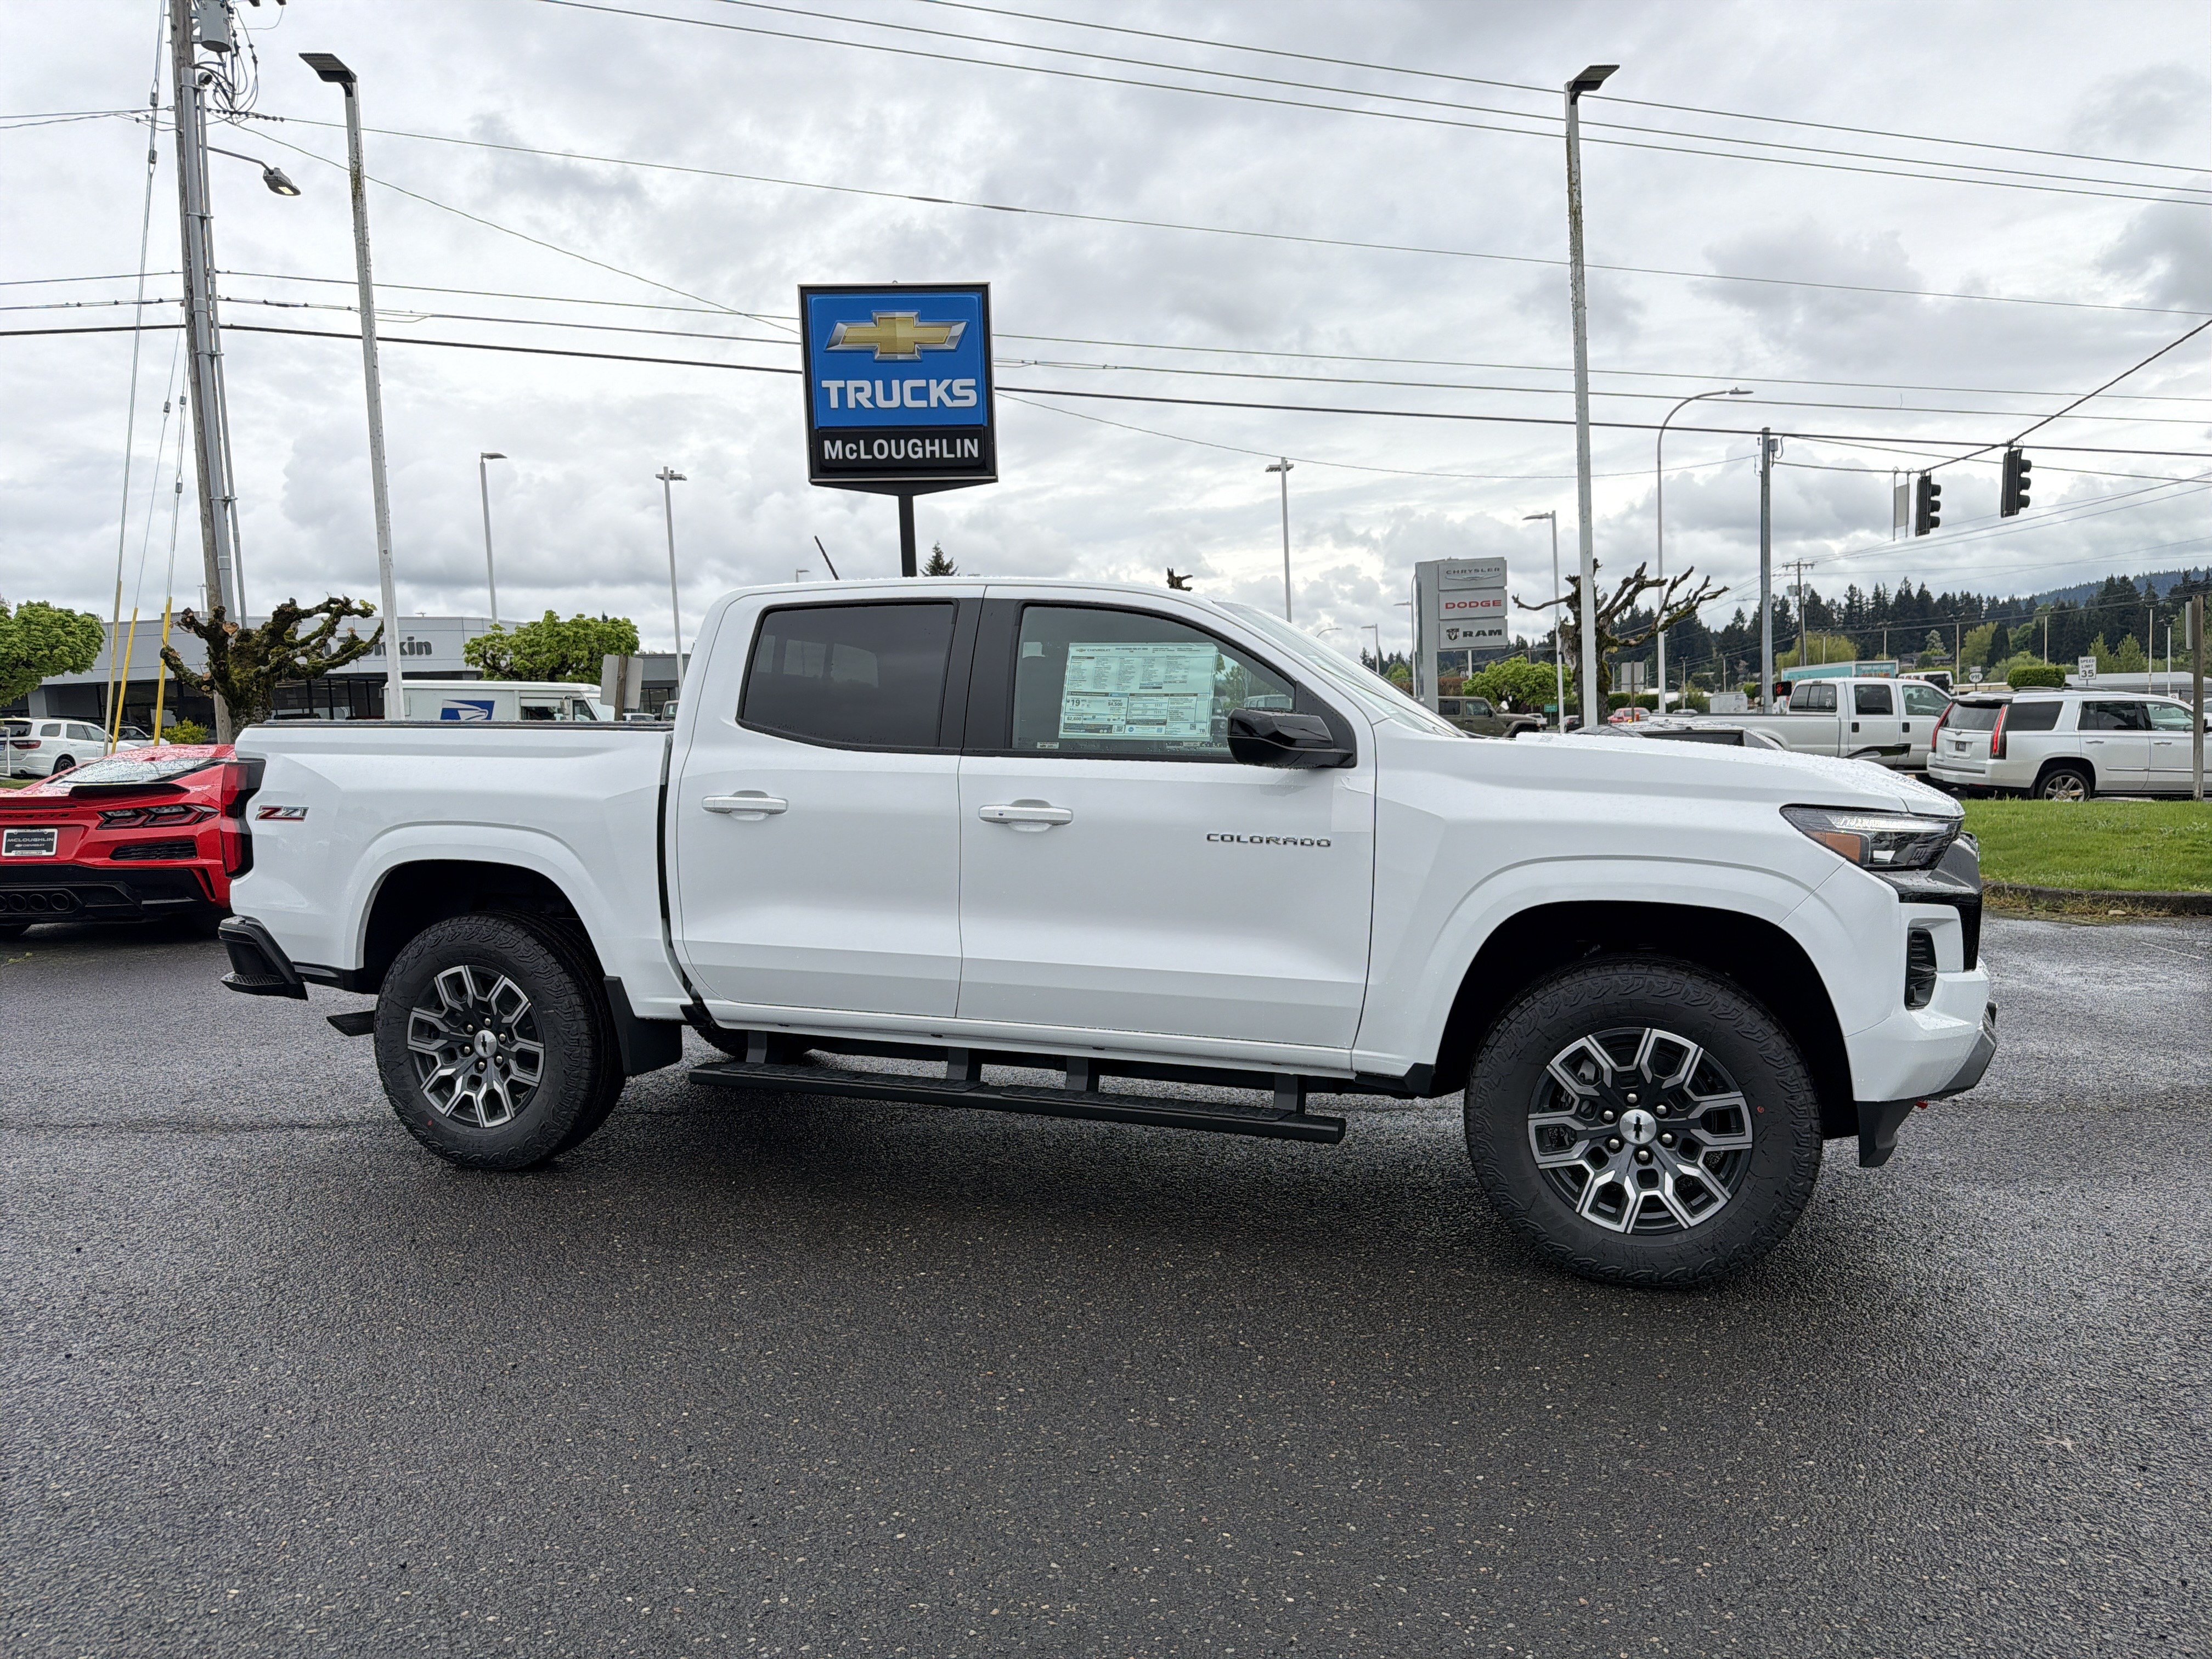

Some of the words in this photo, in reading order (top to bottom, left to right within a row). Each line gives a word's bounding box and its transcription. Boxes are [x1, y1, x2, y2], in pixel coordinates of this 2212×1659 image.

[821, 379, 977, 409] TRUCKS
[823, 438, 979, 460] McLOUGHLIN
[1445, 600, 1502, 610] DODGE
[1462, 629, 1502, 637] RAM
[2081, 669, 2094, 678] 35
[255, 805, 309, 822] Z71
[1207, 833, 1331, 847] COLORADO
